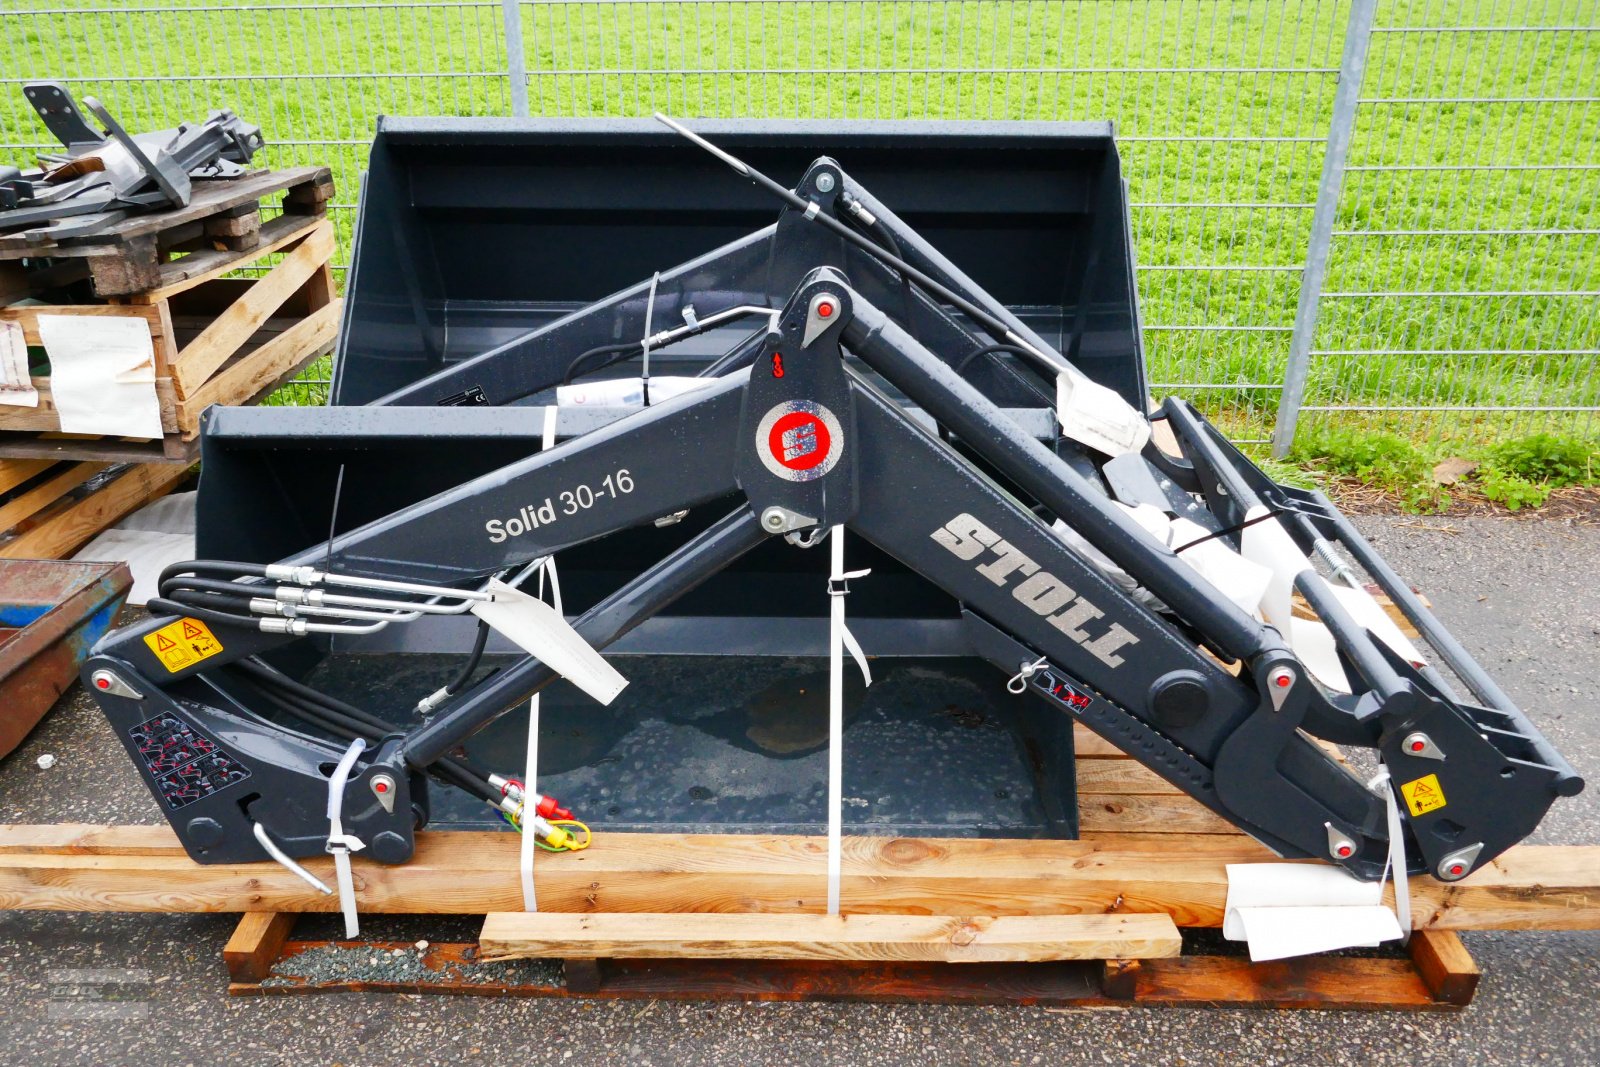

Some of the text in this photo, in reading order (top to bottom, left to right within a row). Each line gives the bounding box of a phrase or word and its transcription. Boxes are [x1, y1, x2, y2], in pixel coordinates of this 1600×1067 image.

[485, 468, 634, 543] Solid 30-16
[929, 512, 1140, 669] STOLL
